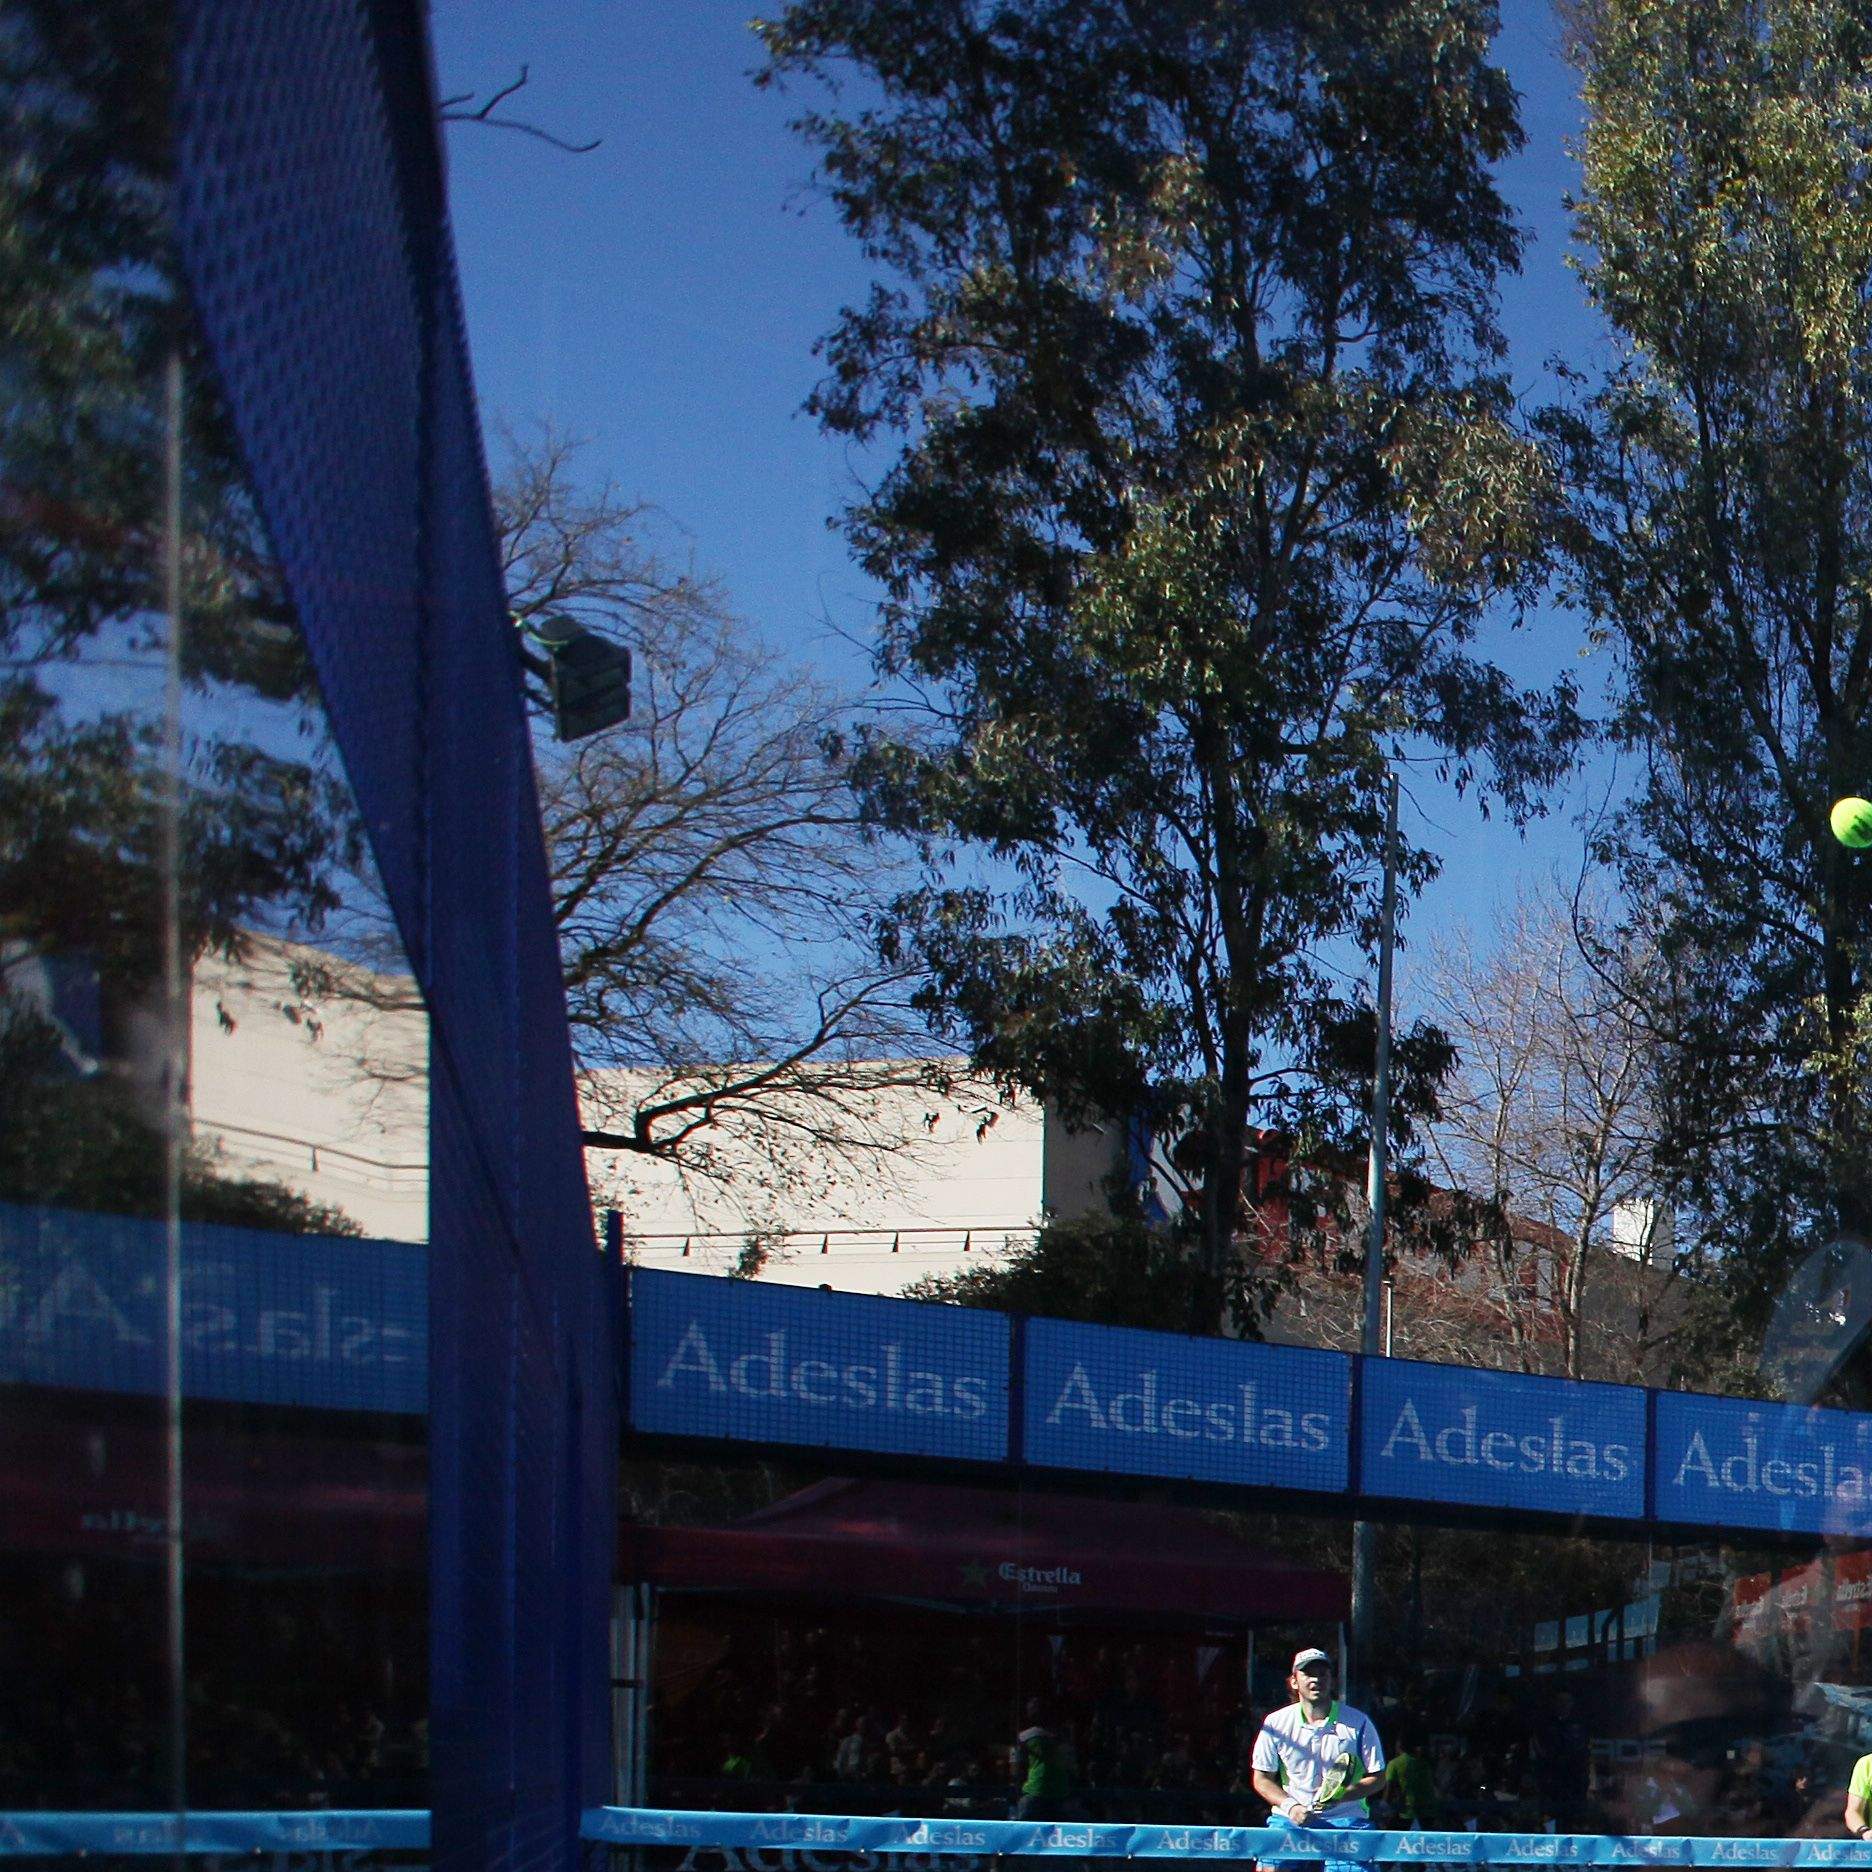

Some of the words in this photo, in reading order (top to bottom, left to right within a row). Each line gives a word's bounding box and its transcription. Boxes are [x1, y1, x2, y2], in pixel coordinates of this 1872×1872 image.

[655, 1319, 988, 1420] Adeslas
[1044, 1361, 1331, 1453] Adeslas
[1380, 1398, 1630, 1482] Adeslas
[600, 1815, 701, 1839] Adeslas
[749, 1819, 849, 1844] Adeslas
[1027, 1827, 1118, 1850] Adeslas
[1155, 1829, 1241, 1852] Adeslas
[1279, 1832, 1360, 1854] Adeslas
[1394, 1836, 1471, 1856] Adeslas
[1710, 1841, 1778, 1861] Adeslas
